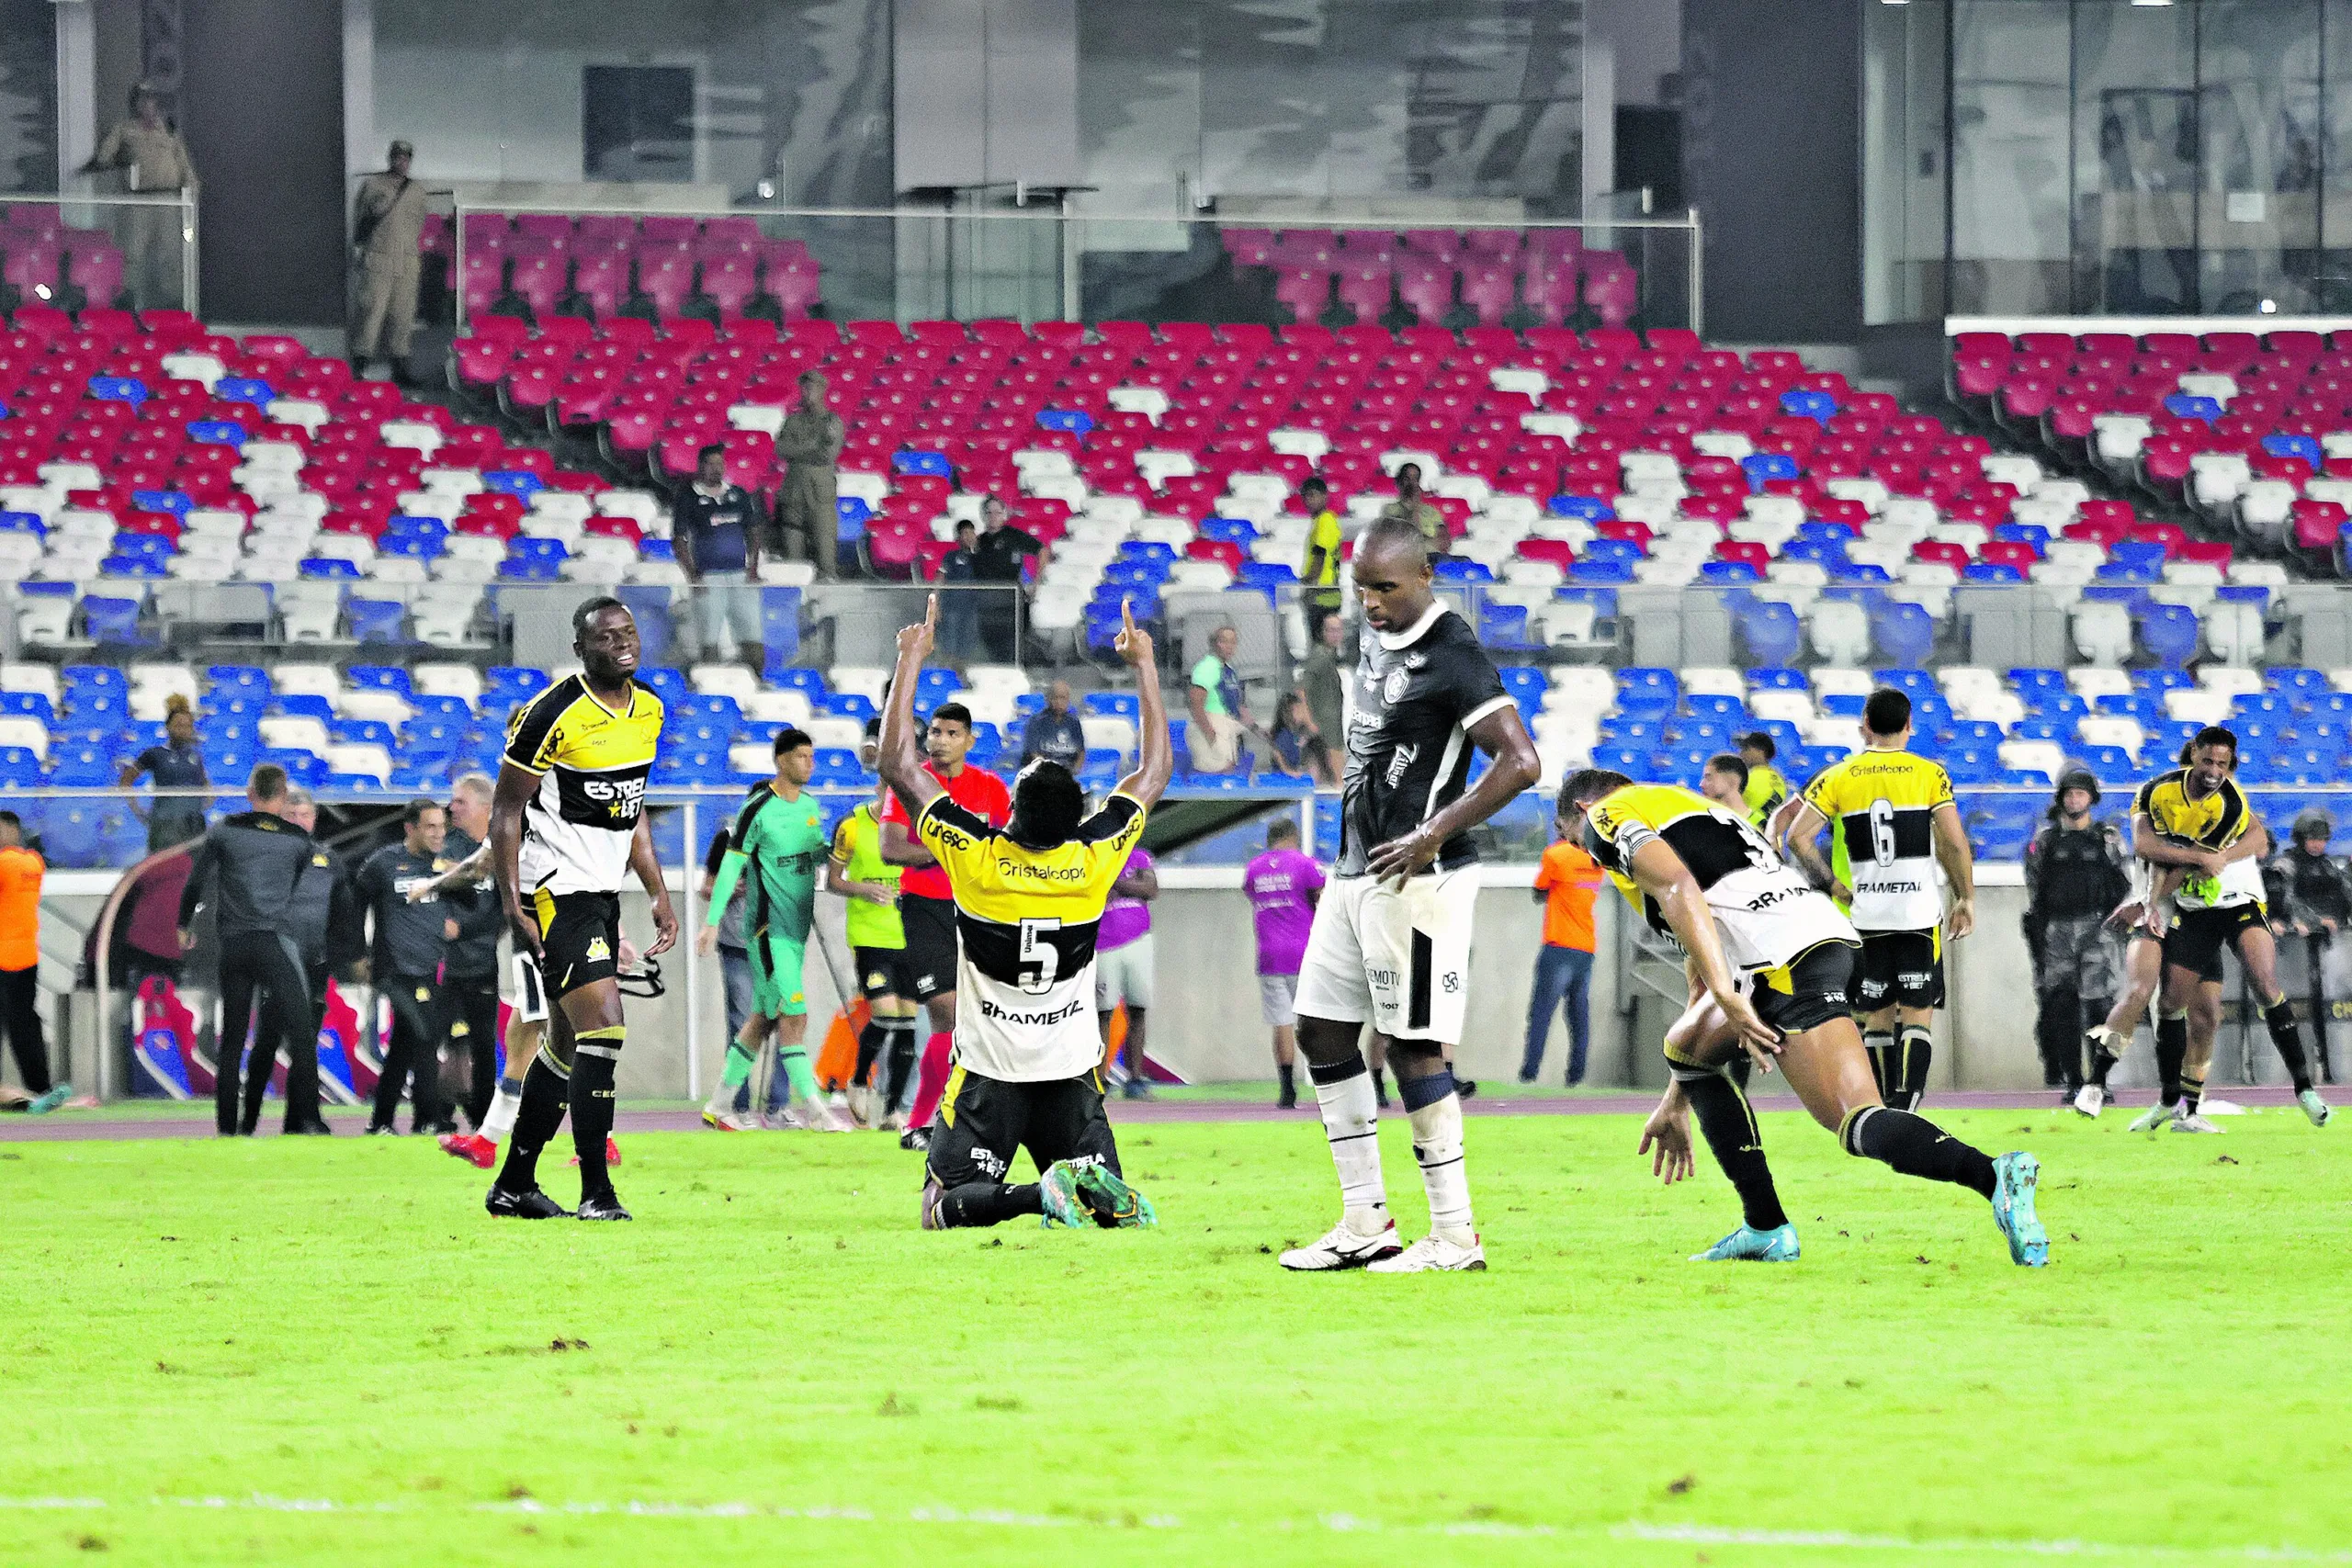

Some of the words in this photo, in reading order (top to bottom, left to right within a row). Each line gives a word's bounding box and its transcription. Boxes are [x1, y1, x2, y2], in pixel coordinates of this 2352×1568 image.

[1849, 764, 1914, 777] Cristalcopo
[1870, 798, 1895, 867] 6
[1017, 917, 1061, 995] 5
